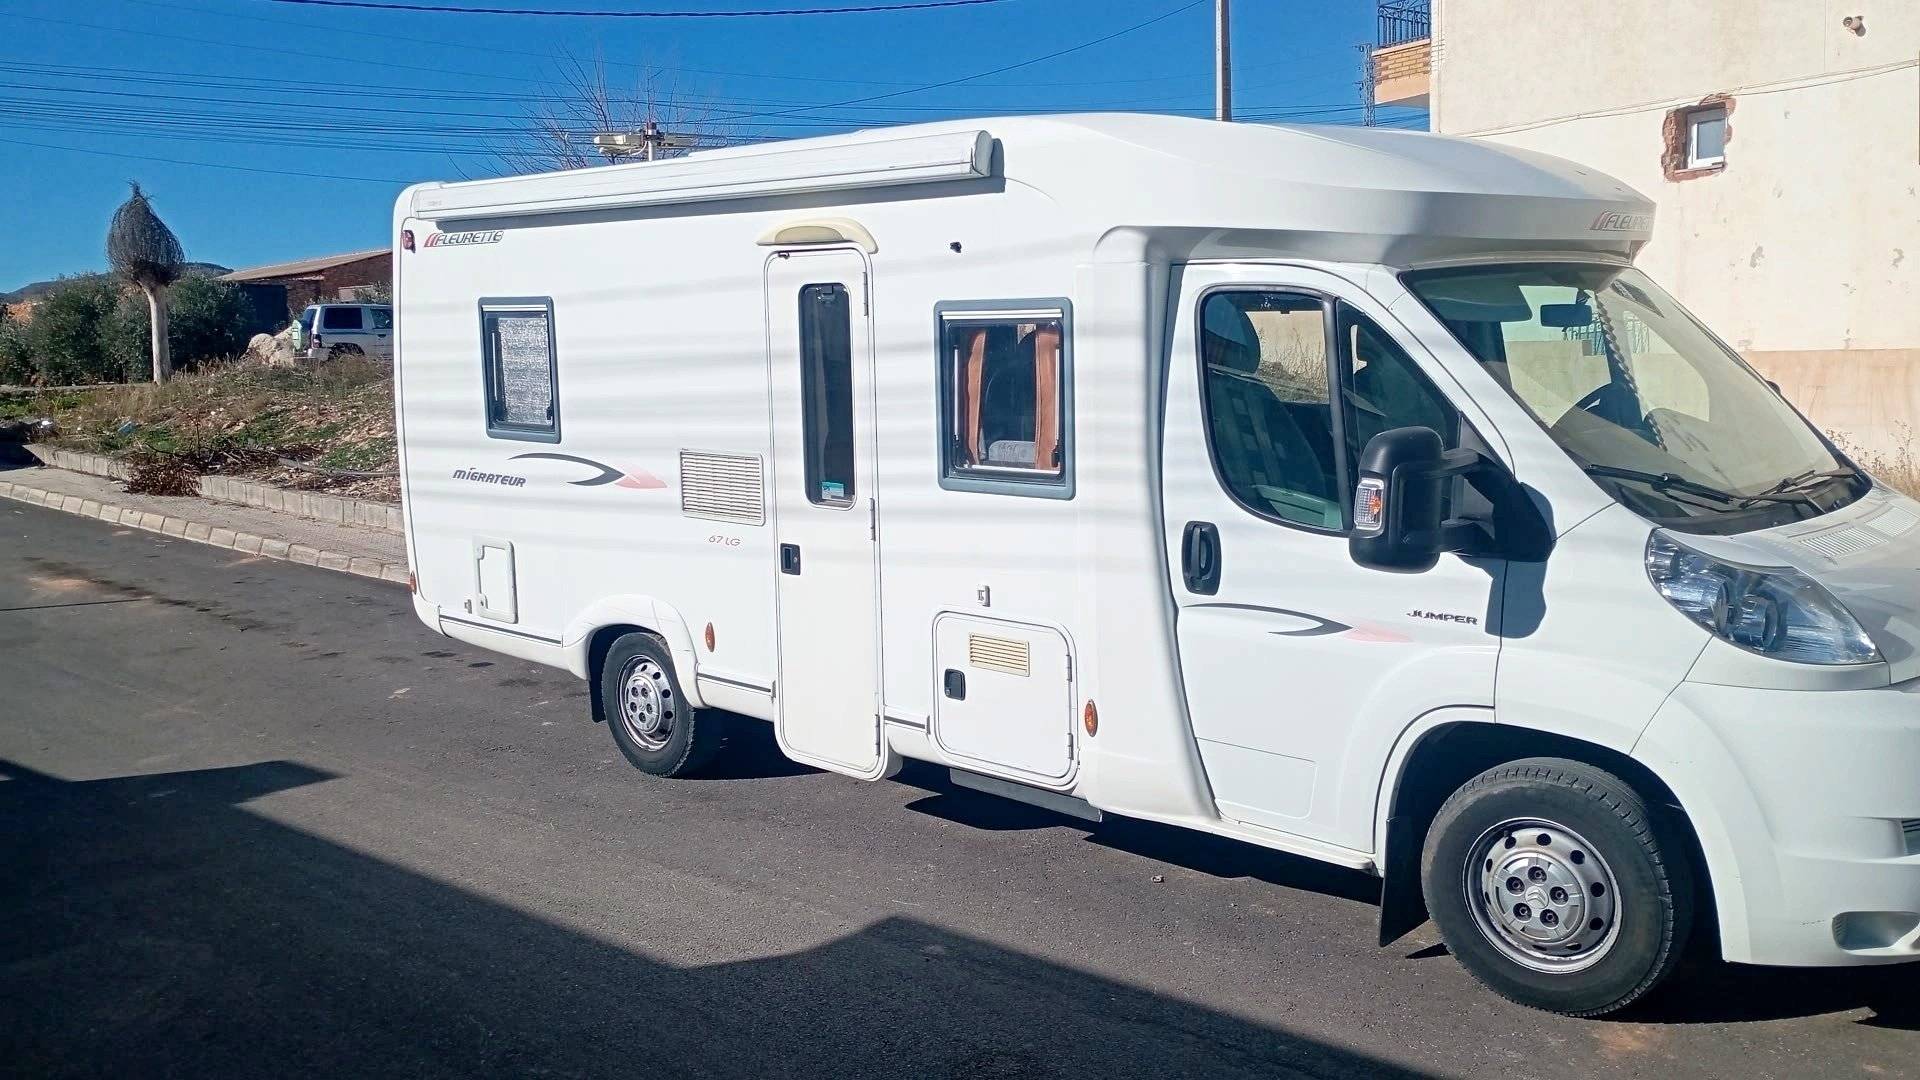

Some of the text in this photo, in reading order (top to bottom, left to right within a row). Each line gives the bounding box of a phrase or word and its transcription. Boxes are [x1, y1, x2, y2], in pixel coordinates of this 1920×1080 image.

[434, 230, 504, 245] FLEURETTE
[709, 535, 724, 544] 67
[1406, 610, 1478, 625] JUMPER
